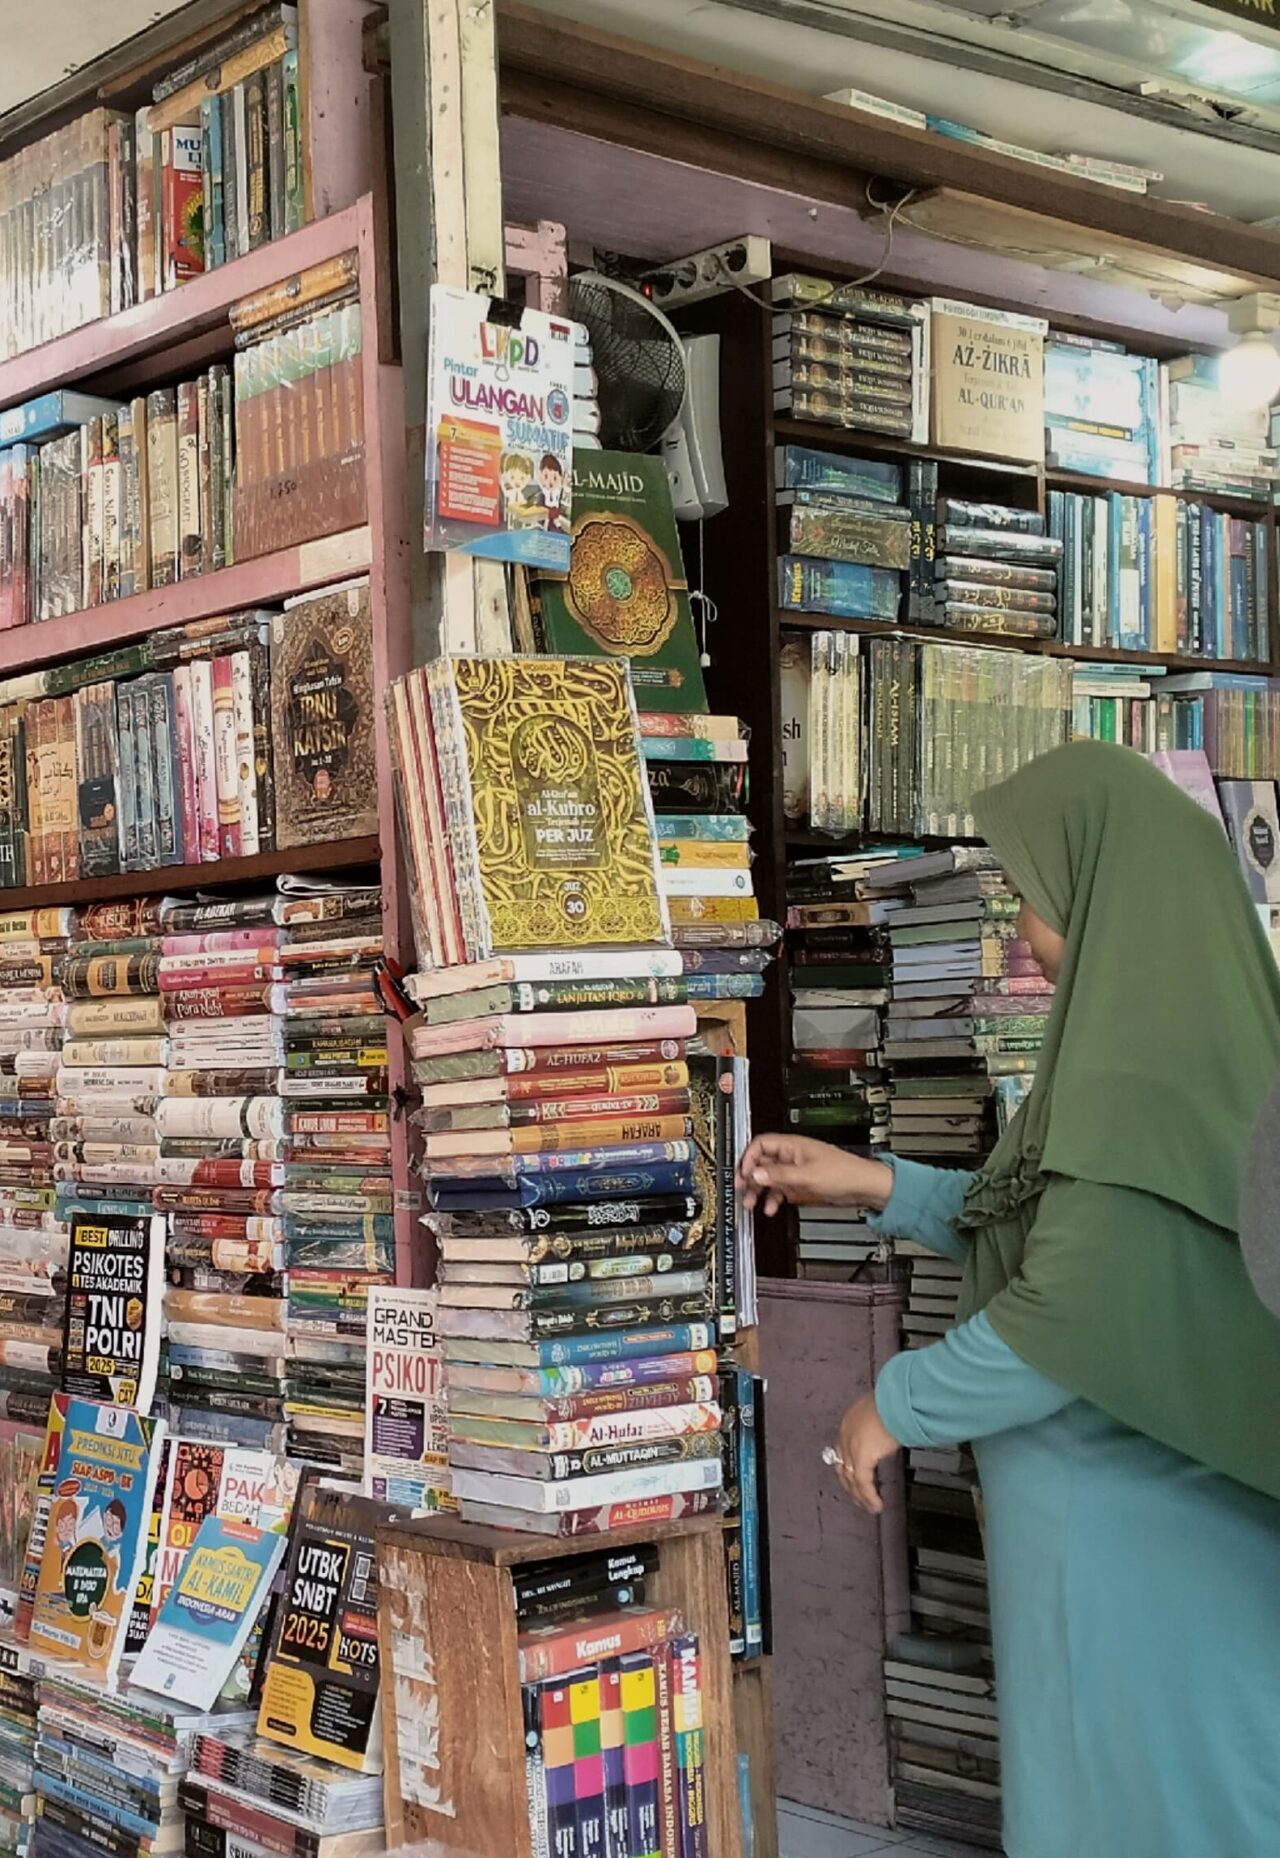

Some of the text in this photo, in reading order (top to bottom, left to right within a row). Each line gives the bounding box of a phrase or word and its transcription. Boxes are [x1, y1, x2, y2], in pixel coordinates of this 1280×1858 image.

[176, 138, 201, 150] MU
[444, 357, 479, 378] Pintar
[451, 375, 544, 422] ULANGAN
[506, 418, 569, 449] SUMATIF
[527, 800, 596, 816] al-Kubro
[536, 828, 594, 843] PER JUZ
[566, 901, 584, 914] 30
[549, 961, 583, 975] ARAFAH
[622, 1122, 661, 1139] ARAFAH
[81, 1230, 144, 1249] BEST DRILLING
[73, 1252, 144, 1278] PSIKOTES
[80, 1275, 142, 1293] TES AKADEMIK
[88, 1295, 124, 1328] TNI
[374, 1308, 433, 1328] GRAND
[86, 1327, 142, 1359] POLRI
[90, 1358, 113, 1373] 2025
[372, 1351, 438, 1395] PSIKOT
[378, 1399, 387, 1415] 7
[590, 1422, 643, 1442] Al-Hufaz
[76, 1437, 114, 1457] PREDIKSI
[590, 1447, 658, 1468] AL-MUTTAQIN
[224, 1478, 266, 1501] PAK
[221, 1499, 261, 1516] BEDAH
[195, 1553, 255, 1582] KAMUS SANTRI
[298, 1545, 344, 1584] UTBK
[608, 1555, 636, 1569] Kamus
[608, 1564, 644, 1582] Lengkap
[186, 1574, 246, 1605] AL-KAMIL
[292, 1578, 337, 1616] SNBT
[284, 1613, 329, 1650] 2025
[340, 1635, 377, 1664] HOTS
[576, 1634, 621, 1659] Kamus
[681, 1648, 697, 1726] KAMUS
[658, 1663, 673, 1802] KAMUS BESAR BAHASA
